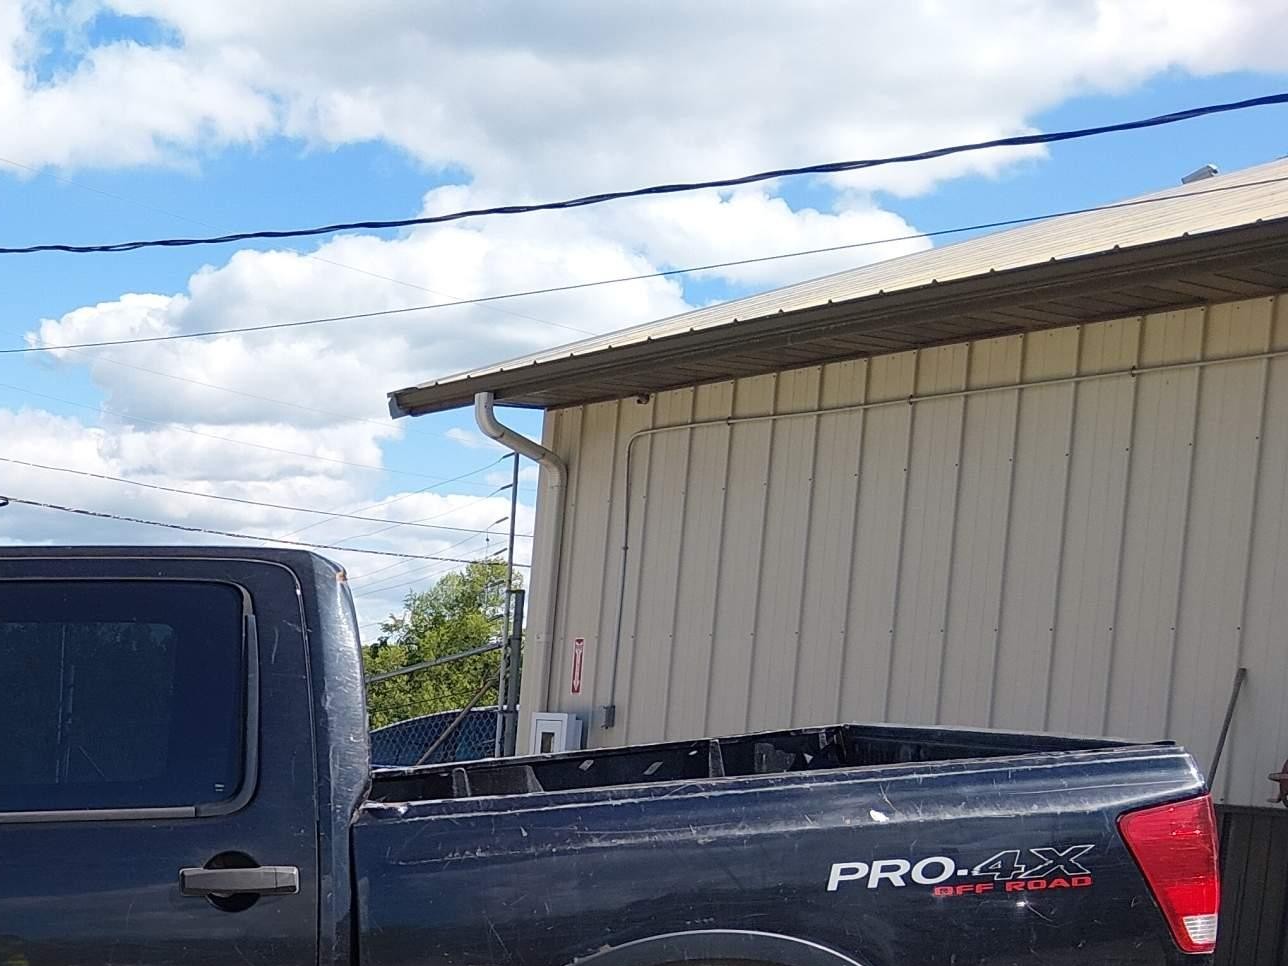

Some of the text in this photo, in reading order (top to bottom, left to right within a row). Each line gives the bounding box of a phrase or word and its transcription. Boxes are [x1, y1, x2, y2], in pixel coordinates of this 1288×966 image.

[826, 844, 1095, 891] PRO-4X
[934, 876, 1093, 897] OFF ROAD
